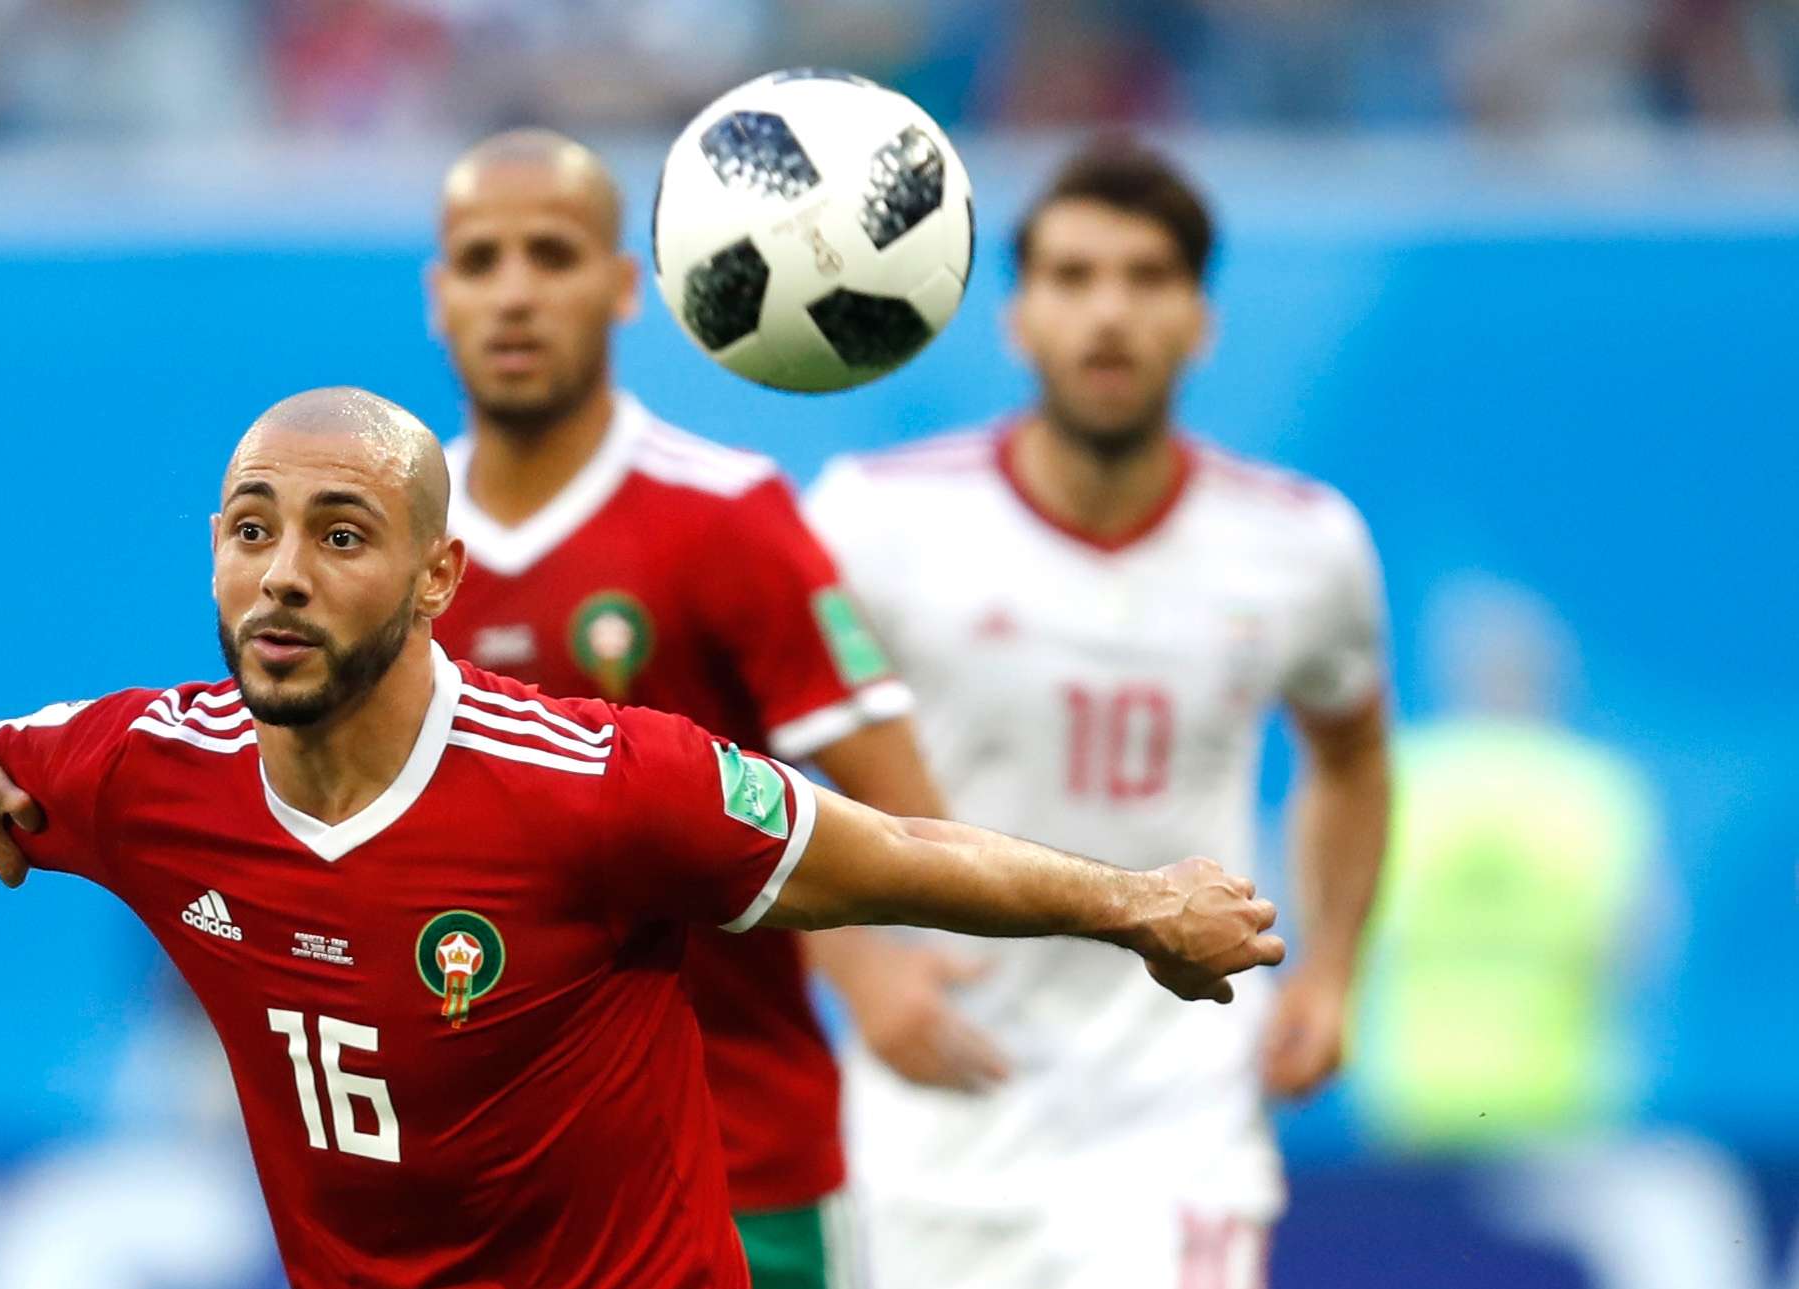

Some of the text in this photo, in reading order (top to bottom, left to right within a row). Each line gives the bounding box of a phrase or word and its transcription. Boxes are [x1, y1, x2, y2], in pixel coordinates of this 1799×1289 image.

[1058, 680, 1177, 800] 10
[181, 909, 243, 942] adidas
[267, 1008, 402, 1163] 16
